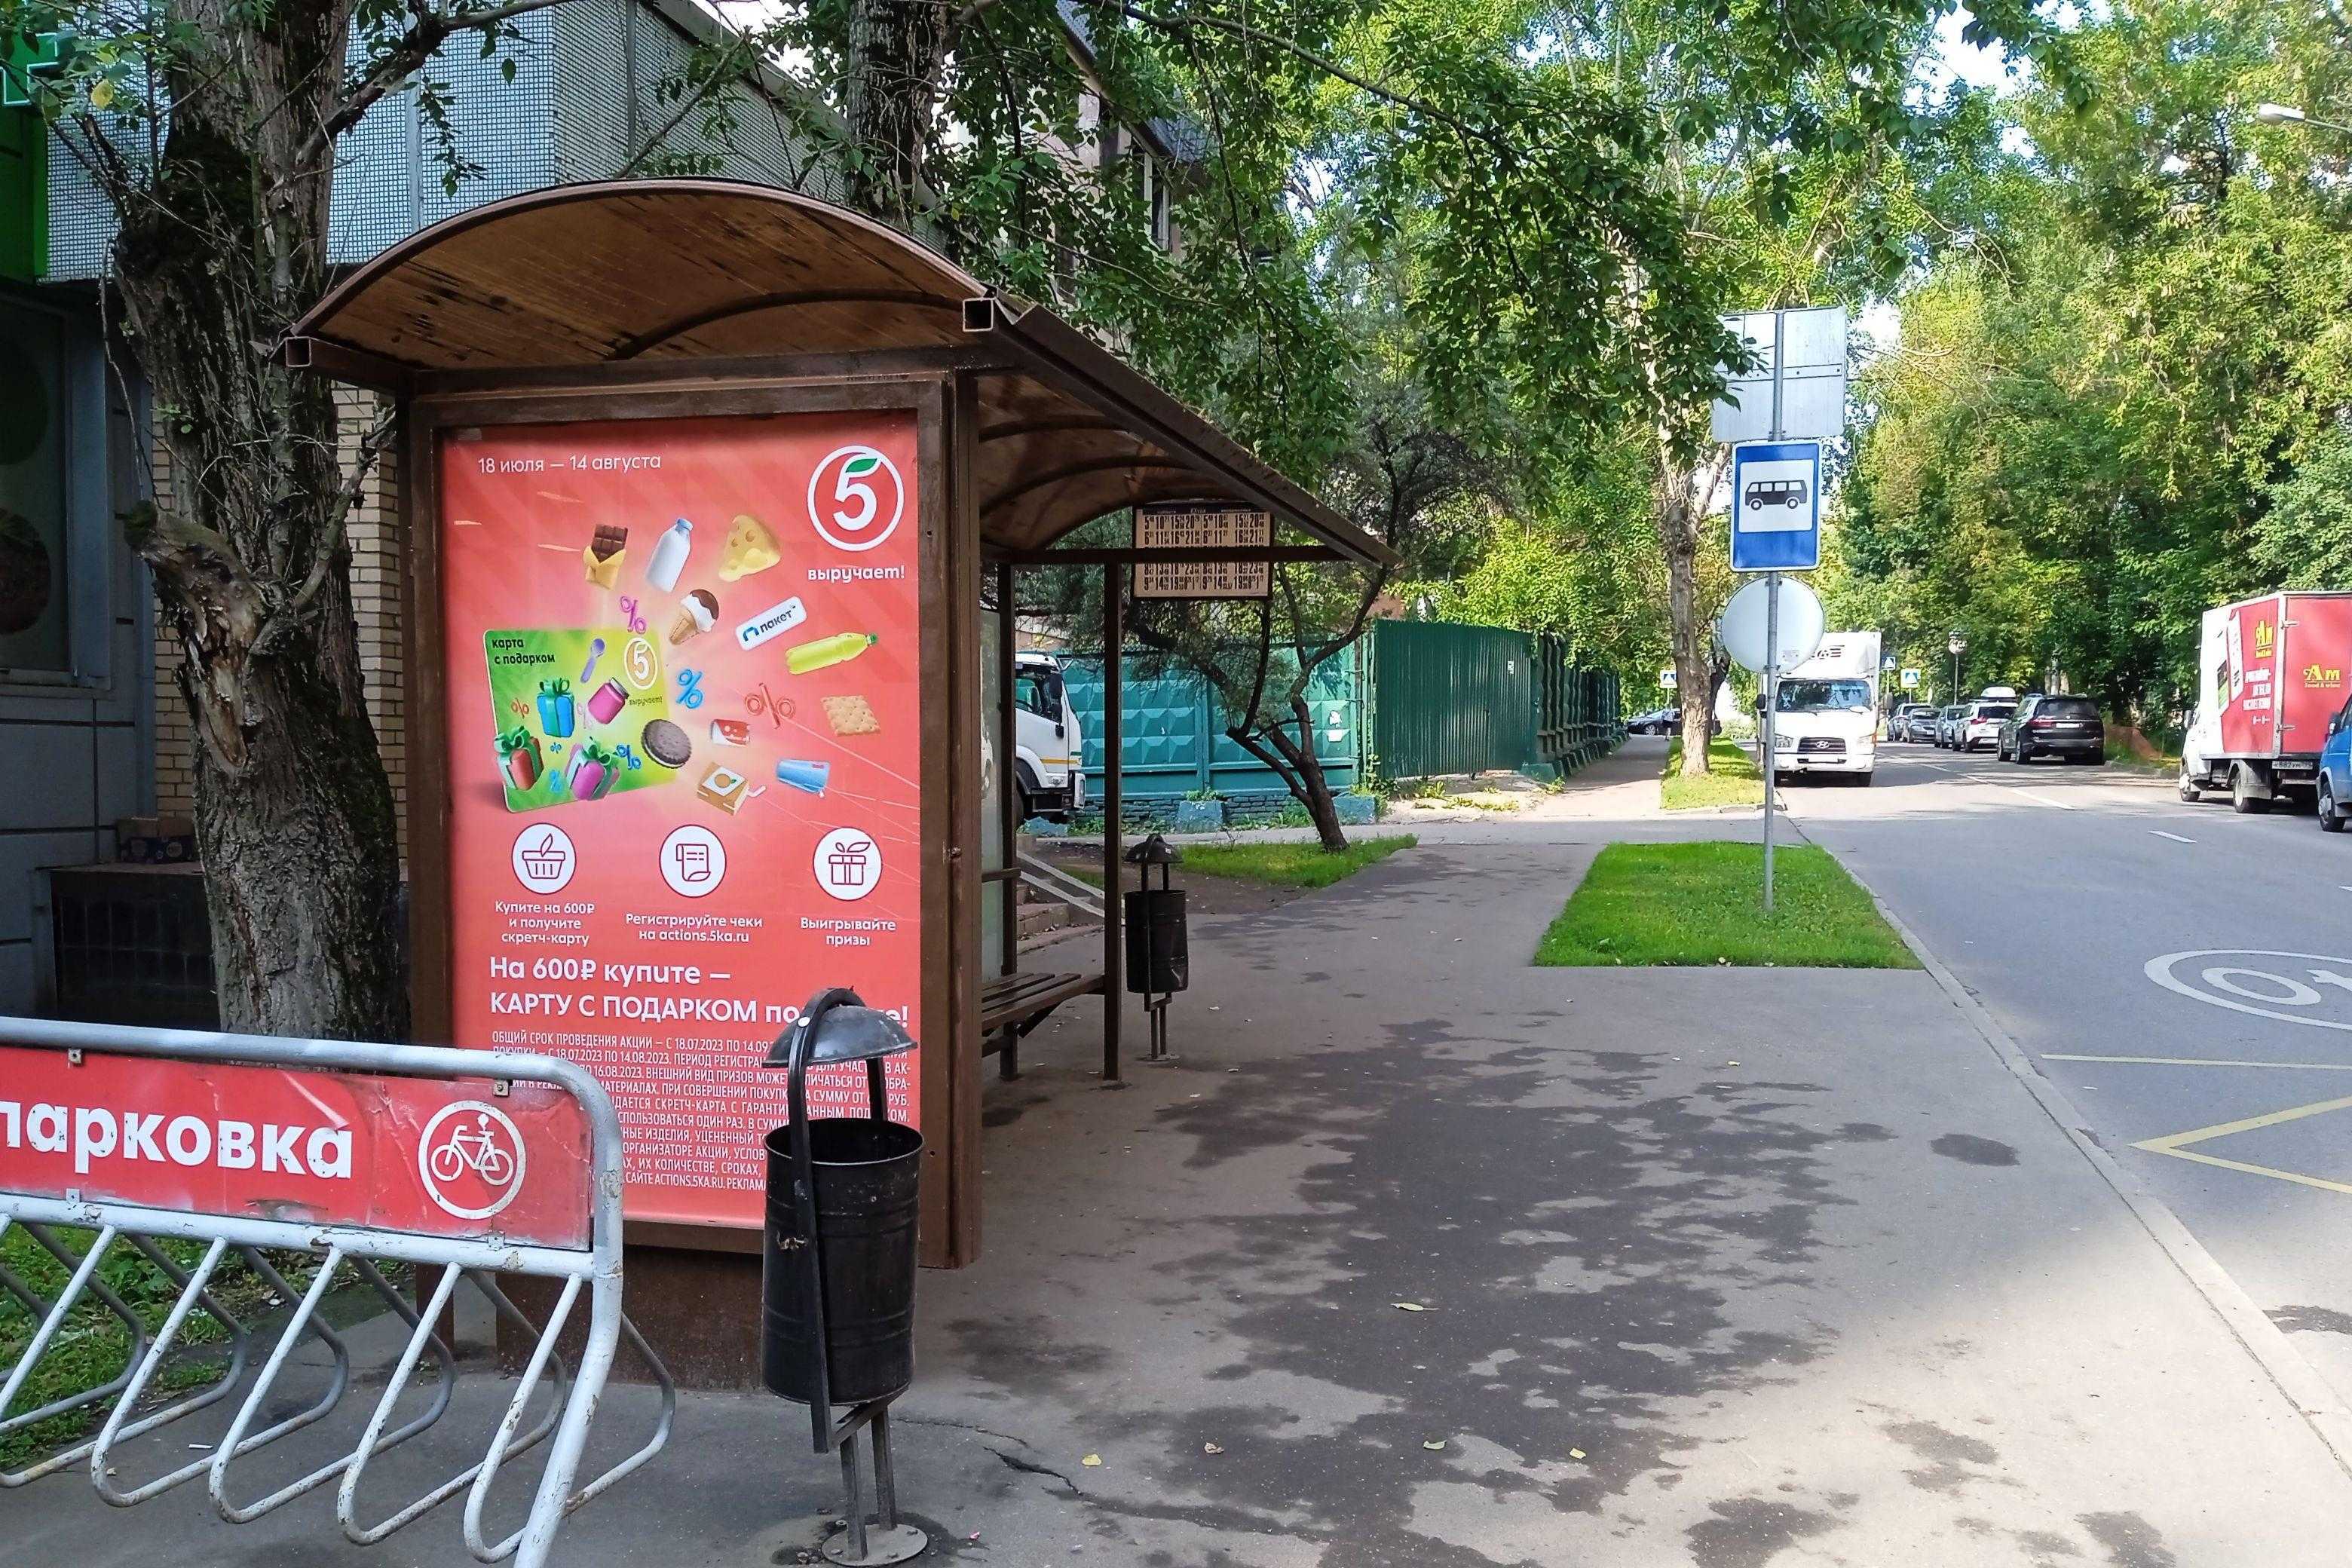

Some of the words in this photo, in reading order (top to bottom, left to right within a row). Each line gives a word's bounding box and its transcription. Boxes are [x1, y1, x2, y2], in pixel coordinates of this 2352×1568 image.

[478, 458, 495, 473] 18
[501, 459, 544, 473] июля
[569, 455, 587, 470] 14
[592, 455, 661, 473] августа
[832, 452, 881, 531] 5
[807, 565, 905, 583] выручает!
[759, 610, 792, 633] пакет
[492, 638, 524, 651] карта
[495, 655, 501, 665] с
[503, 653, 556, 666] подарком
[495, 901, 541, 915] Купите
[544, 904, 561, 914] на
[509, 918, 517, 928] и
[520, 918, 581, 931] получите
[626, 913, 727, 929] Регистрируйте
[730, 917, 763, 927] чеки
[800, 917, 896, 932] Выигрывайте
[501, 933, 590, 947] скретч-карту
[639, 930, 656, 940] на
[659, 929, 749, 942] actions.5ka.ru
[825, 935, 870, 947] призы
[490, 956, 525, 978] На
[532, 957, 597, 981] 600₽
[604, 963, 701, 988] купите
[491, 991, 573, 1015] КАРТУ
[578, 994, 595, 1018] С
[603, 995, 757, 1024] ПОДАРКОМ
[492, 1030, 528, 1046] ОБЩИЙ
[529, 1031, 553, 1045] СРОК
[556, 1033, 617, 1048] ПРОВЕДЕНИЯ
[620, 1036, 653, 1049] АКЦИИ
[666, 1037, 672, 1050] С
[674, 1038, 724, 1052] 18.07.2023
[726, 1040, 740, 1052] ПО
[743, 1040, 774, 1053] 14.09.
[556, 1049, 602, 1062] 18.07.2023
[605, 1050, 618, 1063] ПО
[620, 1051, 672, 1064] 14.08.2023.
[674, 1054, 712, 1069] ПЕРИОД
[714, 1055, 767, 1068] РЕГИСТРА
[839, 1060, 867, 1073] УЧАСТ
[885, 1062, 891, 1073] В
[894, 1062, 911, 1075] АК-
[593, 1065, 644, 1079] 16.08.2023.
[646, 1067, 692, 1081] ВНЕШНИЙ
[694, 1069, 715, 1083] ВИД
[716, 1070, 754, 1083] ПРИЗОВ
[756, 1072, 789, 1085] МОЖЕТ
[804, 1073, 853, 1088] ЛИЧАТЬСЯ
[855, 1076, 868, 1088] ОТ
[885, 1077, 911, 1090] БРА-
[661, 1083, 683, 1095] ПРИ
[683, 1083, 748, 1098] СОВЕРШЕНИИ
[749, 1087, 789, 1101] ПОКУПК
[813, 1089, 850, 1104] СУММУ
[852, 1091, 865, 1104] ОТ
[888, 1093, 910, 1107] РУБ.
[612, 1096, 651, 1110] ДАЕТСЯ
[654, 1098, 727, 1113] СКРЕТЧ-КАРТА
[730, 1101, 737, 1113] С
[617, 1111, 694, 1126] СПОЛЬЗОВАТЬСЯ
[697, 1114, 724, 1129] ОДИН
[726, 1116, 745, 1129] РАЗ.
[748, 1117, 755, 1129] В
[645, 1128, 694, 1144] ИЗДЕЛИЯ,
[695, 1130, 754, 1145] УЦЕНЕННЫЙ
[623, 1142, 693, 1156] ОРГАНИЗАТОРЕ
[695, 1145, 732, 1161] АКЦИИ,
[733, 1147, 767, 1161] УСЛОВ
[639, 1157, 652, 1170] ИХ
[654, 1159, 718, 1174] КОЛИЧЕСТВЕ,
[721, 1162, 762, 1178] СРОКАХ,
[625, 1170, 654, 1184] САЙТЕ
